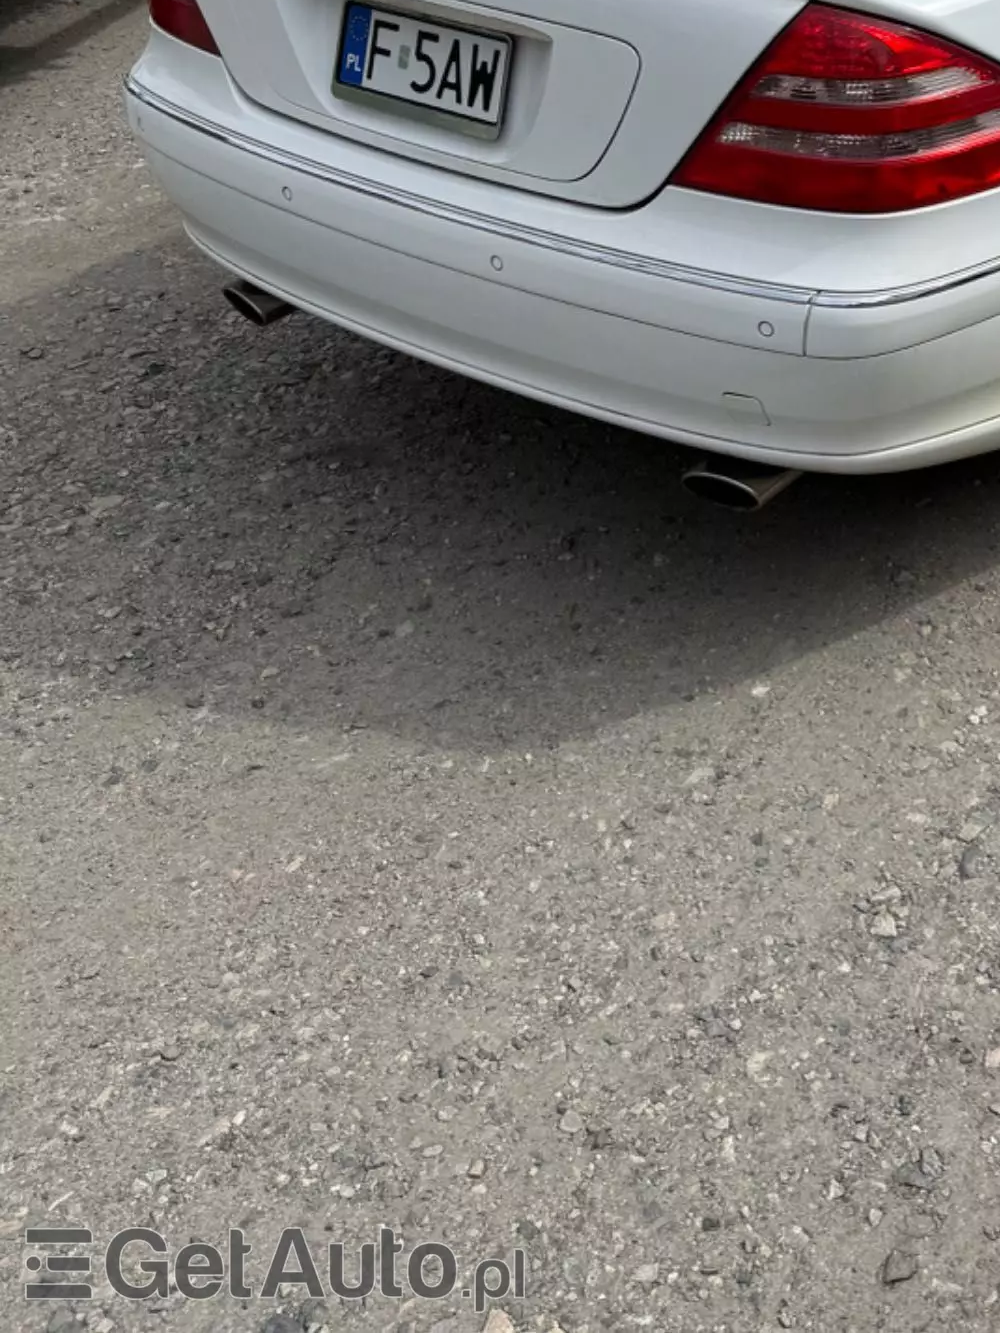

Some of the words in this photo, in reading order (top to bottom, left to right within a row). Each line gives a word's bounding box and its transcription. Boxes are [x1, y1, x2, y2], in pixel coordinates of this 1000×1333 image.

[345, 53, 362, 72] PL
[366, 19, 400, 81] F
[410, 29, 500, 113] 5AW
